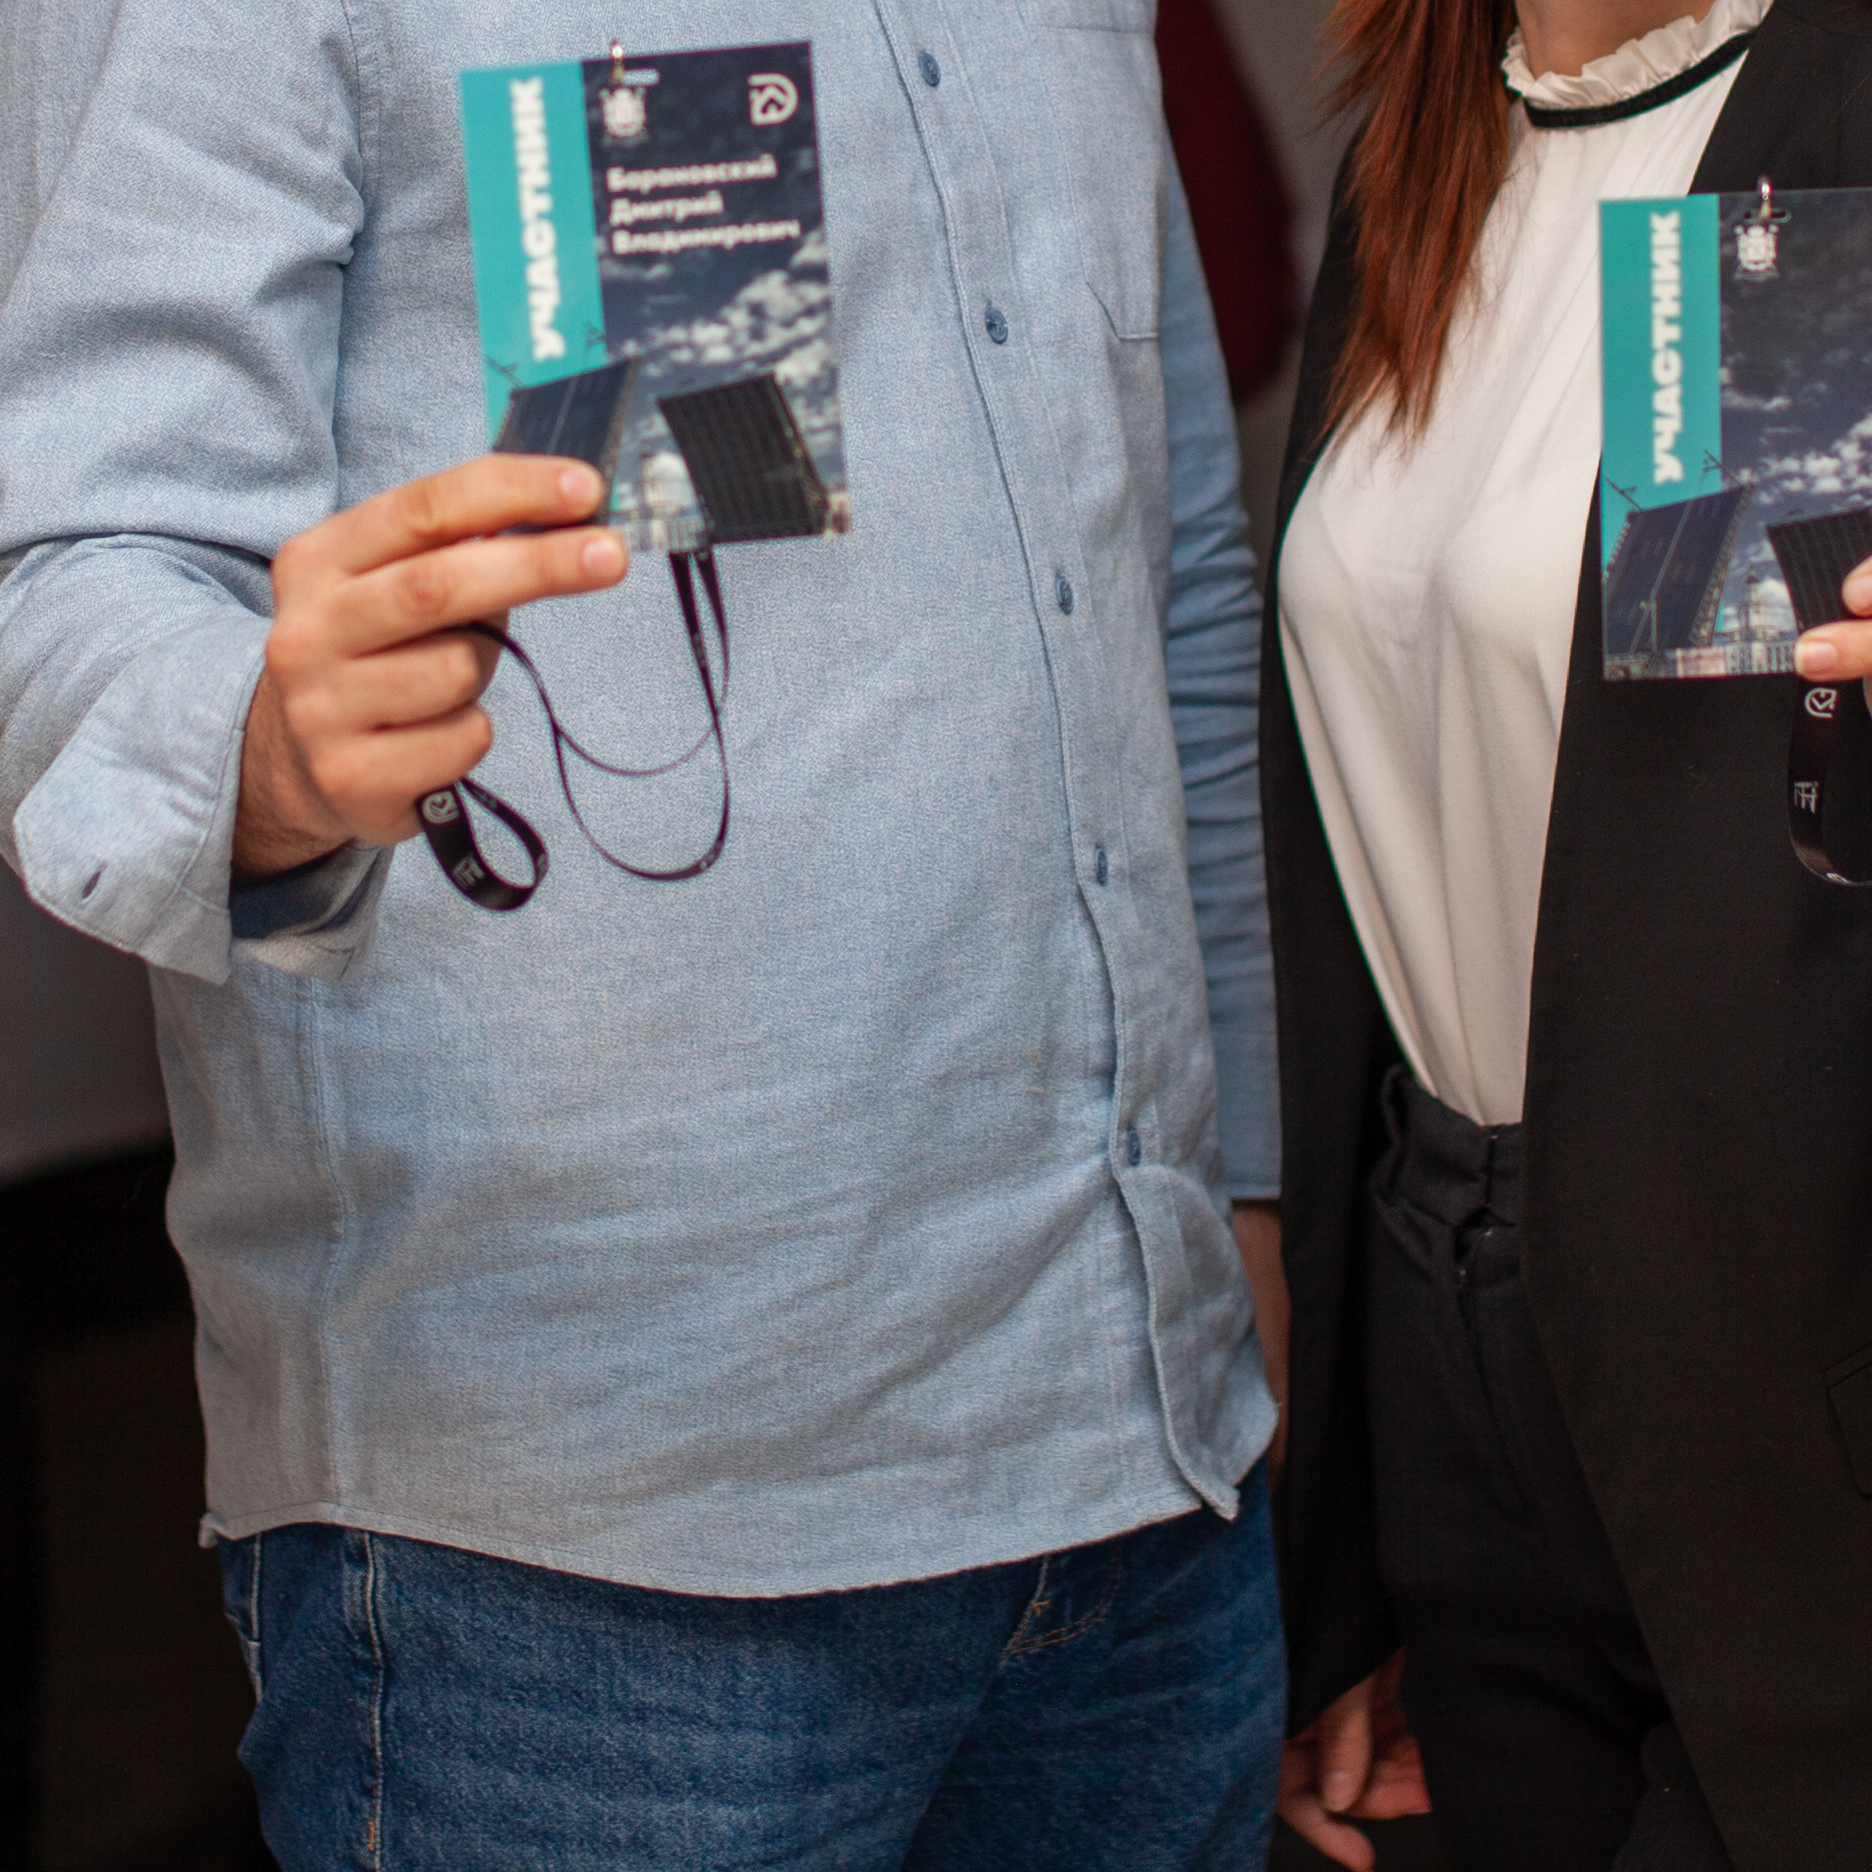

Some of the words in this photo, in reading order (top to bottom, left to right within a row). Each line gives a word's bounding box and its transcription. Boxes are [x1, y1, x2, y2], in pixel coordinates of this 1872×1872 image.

[510, 76, 567, 361] УЧАСТНИК
[609, 189, 724, 226] Дмитрий
[612, 219, 801, 254] Владимирович
[1650, 210, 1685, 485] УЧАСТНИК
